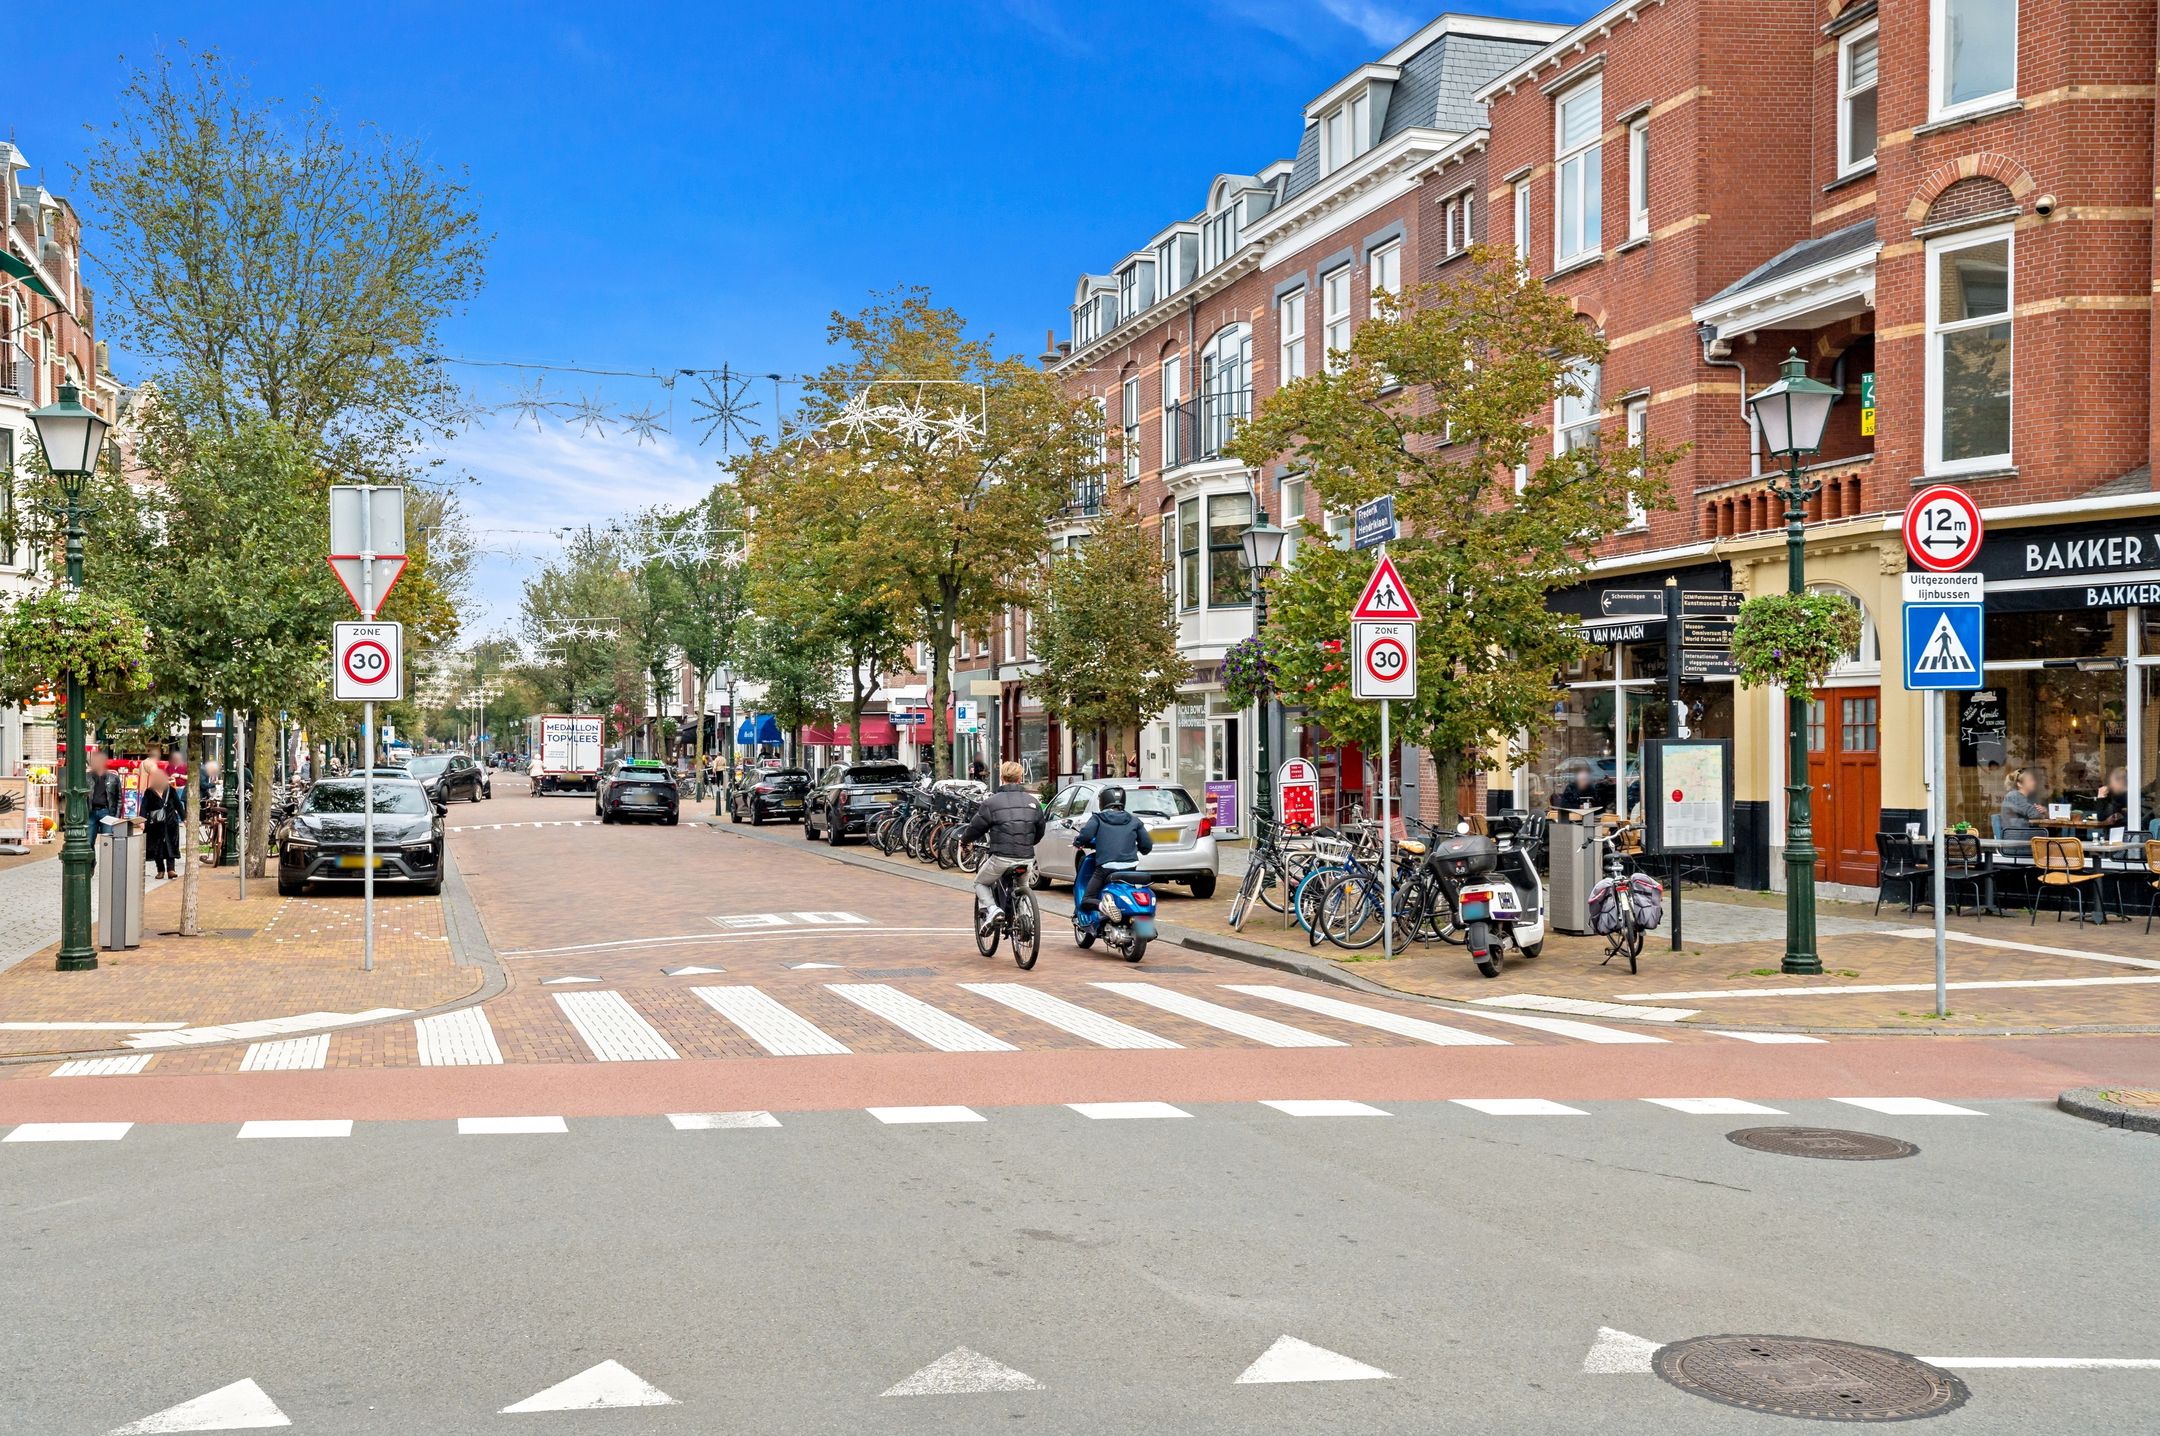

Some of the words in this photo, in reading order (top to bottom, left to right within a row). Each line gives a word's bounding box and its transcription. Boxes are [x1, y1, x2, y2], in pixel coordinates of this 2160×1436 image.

[1358, 504, 1378, 519] Frederik
[1358, 517, 1388, 535] Hendriklaan
[2026, 536, 2143, 572] BAKKER
[1910, 575, 1978, 586] Uitgezonderd
[1919, 589, 1970, 600] lijnbussen
[2087, 584, 2160, 606] BAKKER
[353, 628, 381, 636] ZONE
[1375, 627, 1399, 635] ZONE
[1593, 628, 1608, 642] VAN
[1610, 624, 1644, 641] MAANEN
[352, 653, 383, 669] 30
[1374, 651, 1401, 668] 30
[546, 723, 599, 732] MEDAILLON
[546, 734, 599, 743] TOPVLEES
